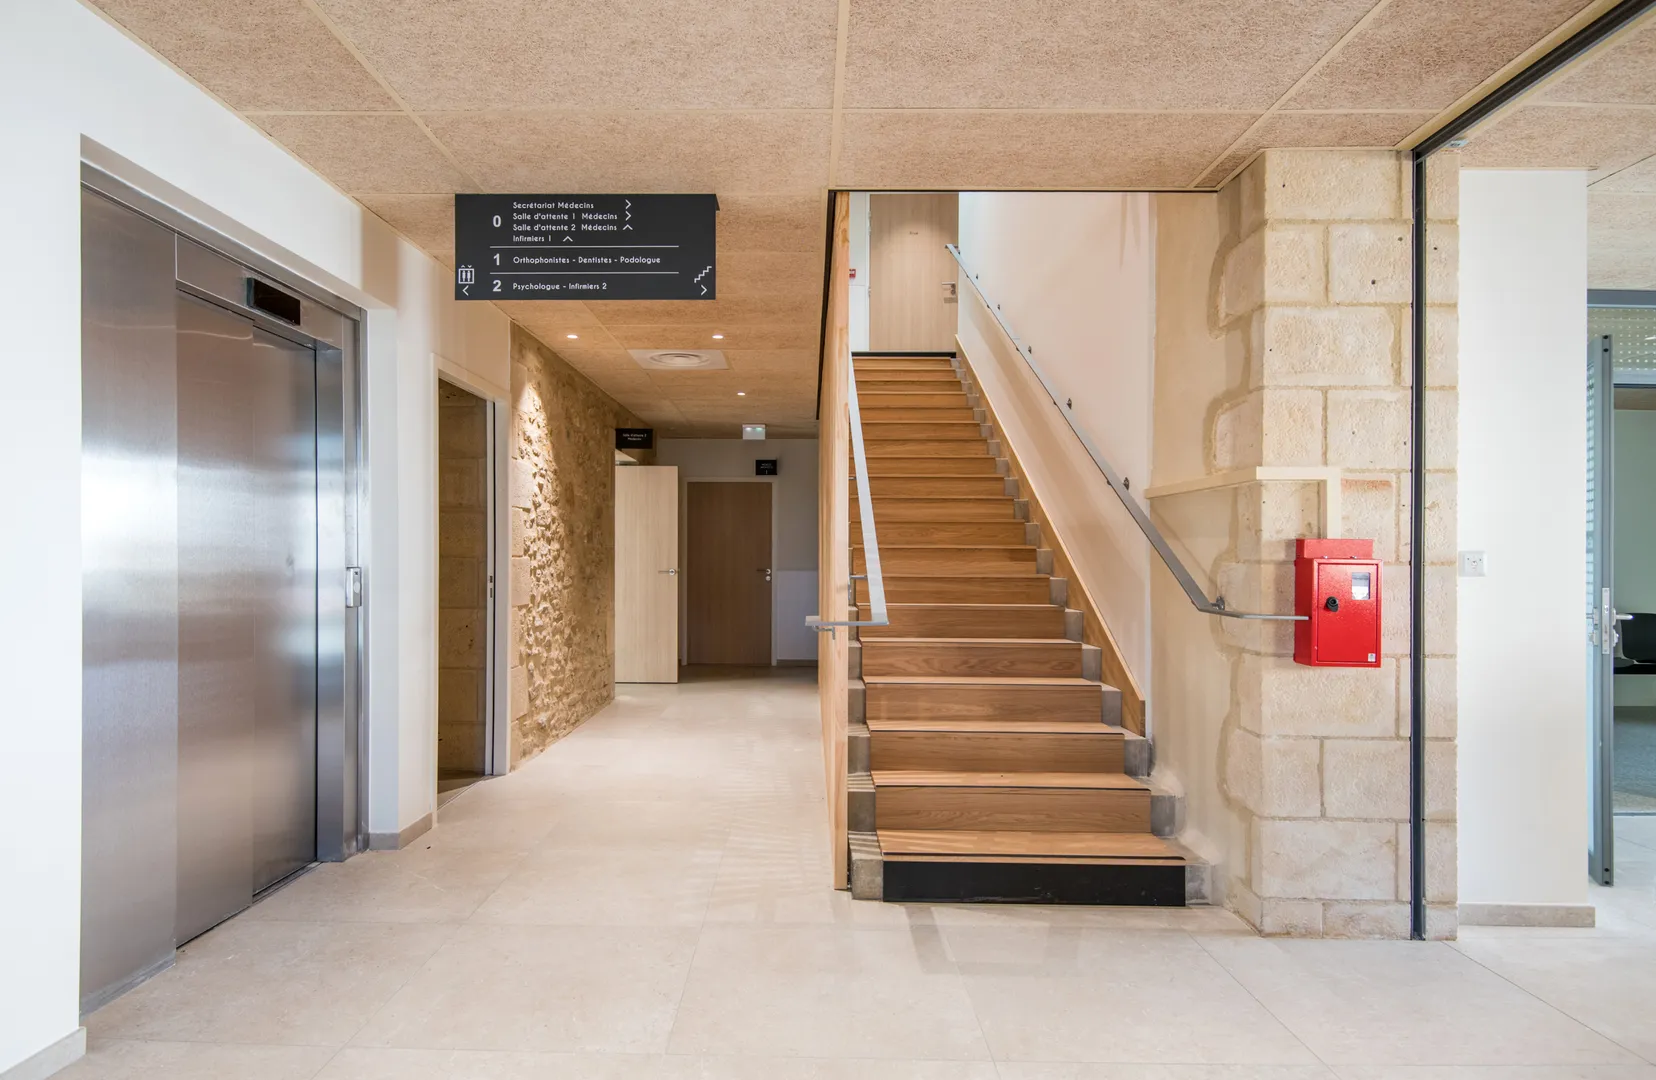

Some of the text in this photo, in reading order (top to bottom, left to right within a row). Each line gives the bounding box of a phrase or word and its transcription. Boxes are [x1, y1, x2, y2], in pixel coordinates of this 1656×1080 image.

[492, 215, 502, 228] 0
[493, 253, 500, 266] 1
[512, 256, 570, 265] Orthophonistes
[578, 256, 612, 264] Dentistes
[620, 256, 661, 265] Podologue
[492, 280, 502, 292] 2
[512, 282, 561, 291] Psychologue
[568, 282, 600, 290] Infirmiers
[602, 282, 607, 290] 2
